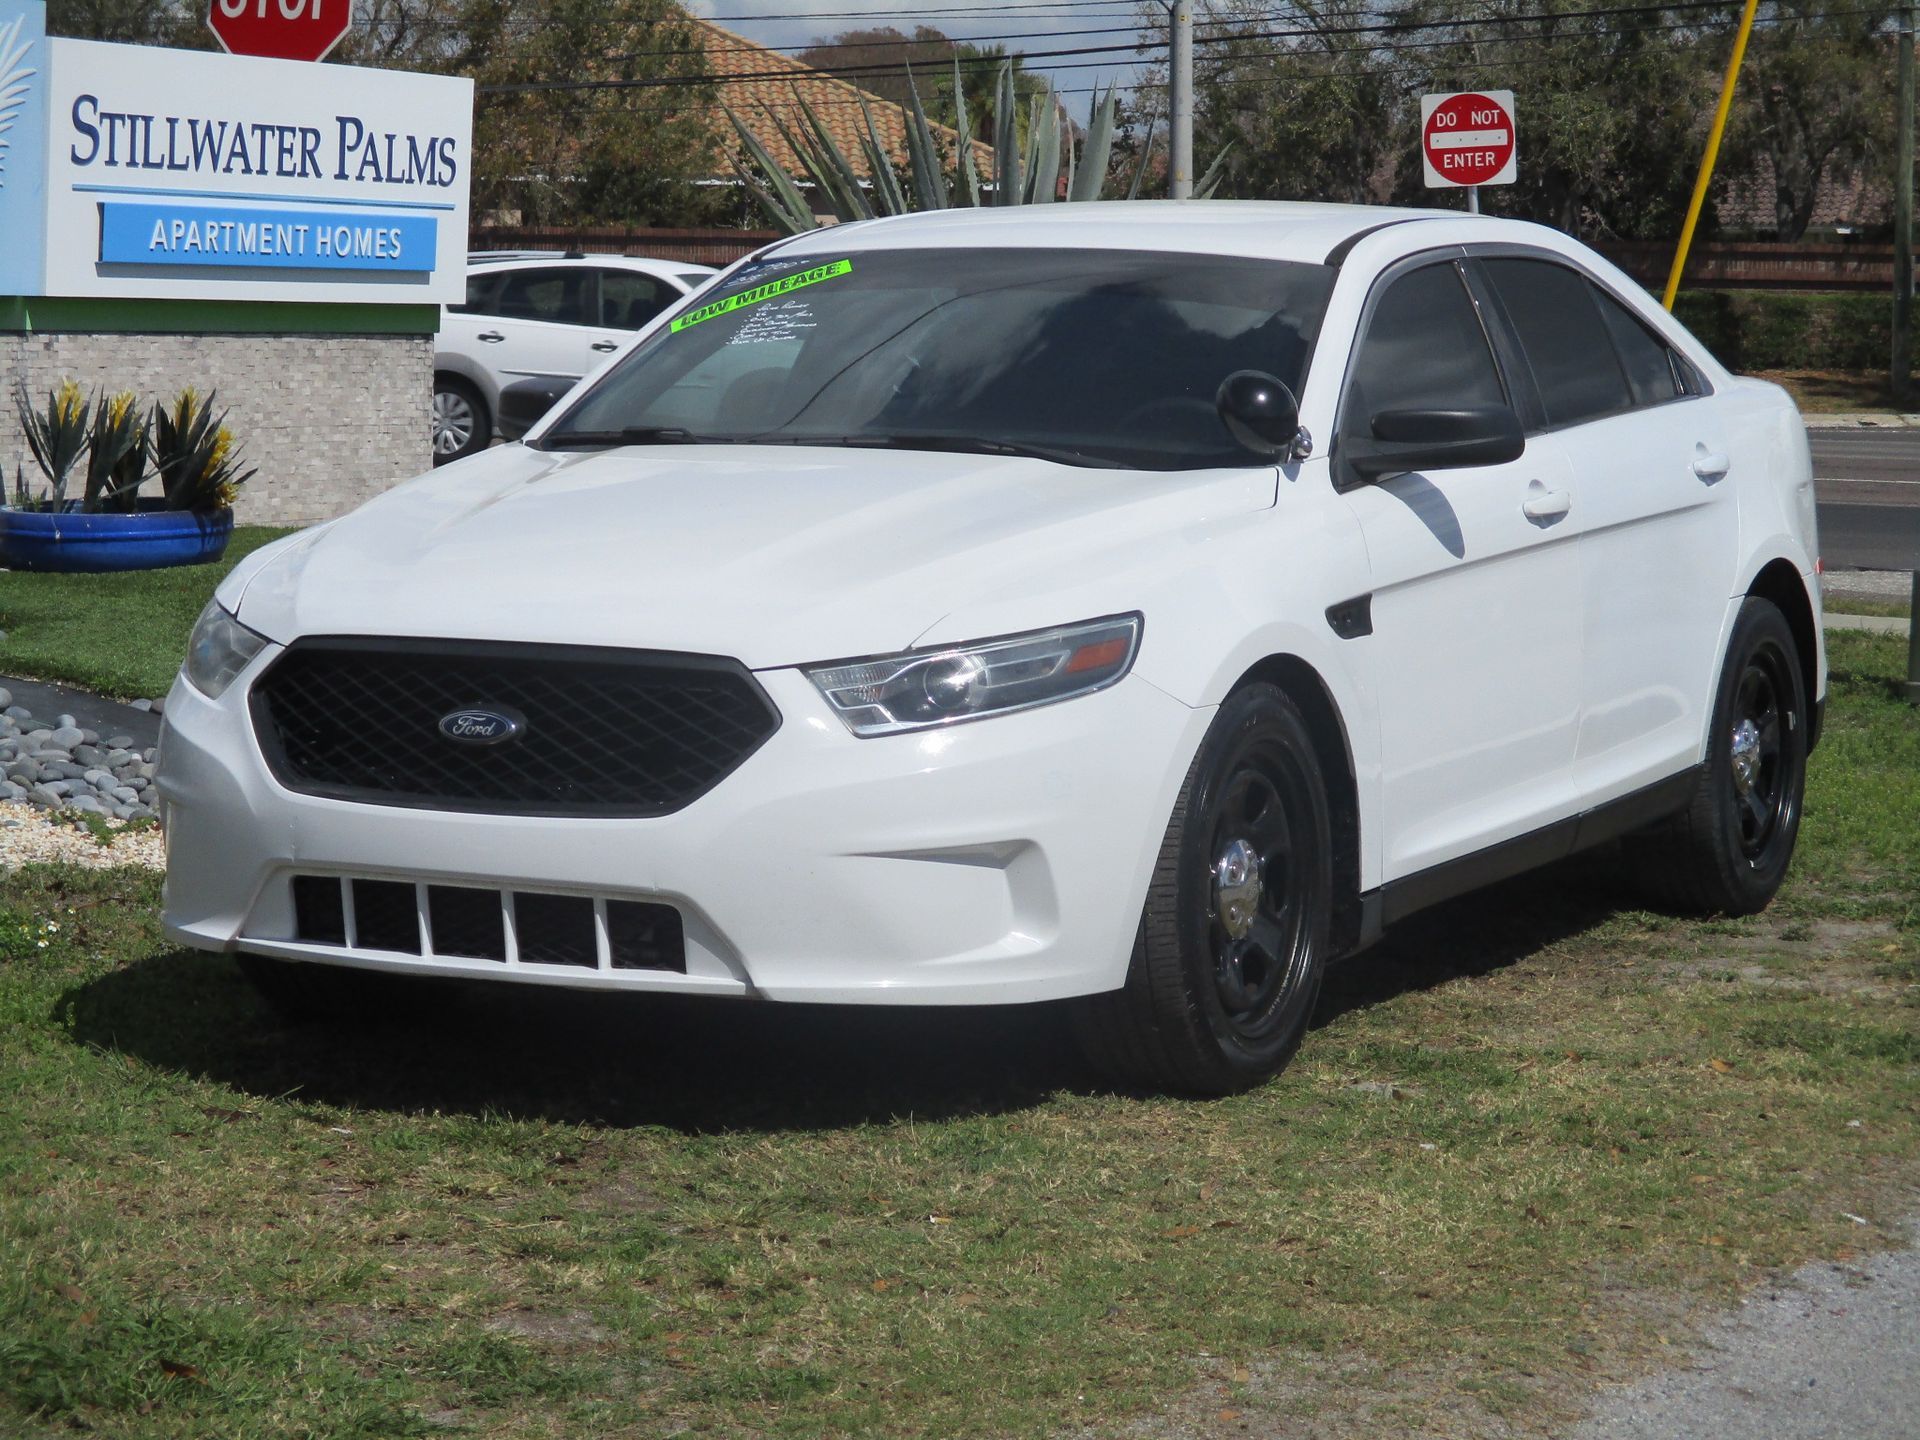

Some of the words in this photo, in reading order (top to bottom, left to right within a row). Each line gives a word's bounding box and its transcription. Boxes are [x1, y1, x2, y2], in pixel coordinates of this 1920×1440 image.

[1436, 112, 1457, 127] DO
[1471, 109, 1500, 125] NOT
[71, 94, 322, 177] STILLWATER
[333, 116, 457, 187] PALMS
[1443, 151, 1495, 168] ENTER
[149, 219, 309, 256] APARTMENT
[315, 226, 402, 260] HOMES
[680, 300, 731, 326] LOW
[736, 263, 841, 305] MILEAGE
[452, 715, 496, 736] Ford
